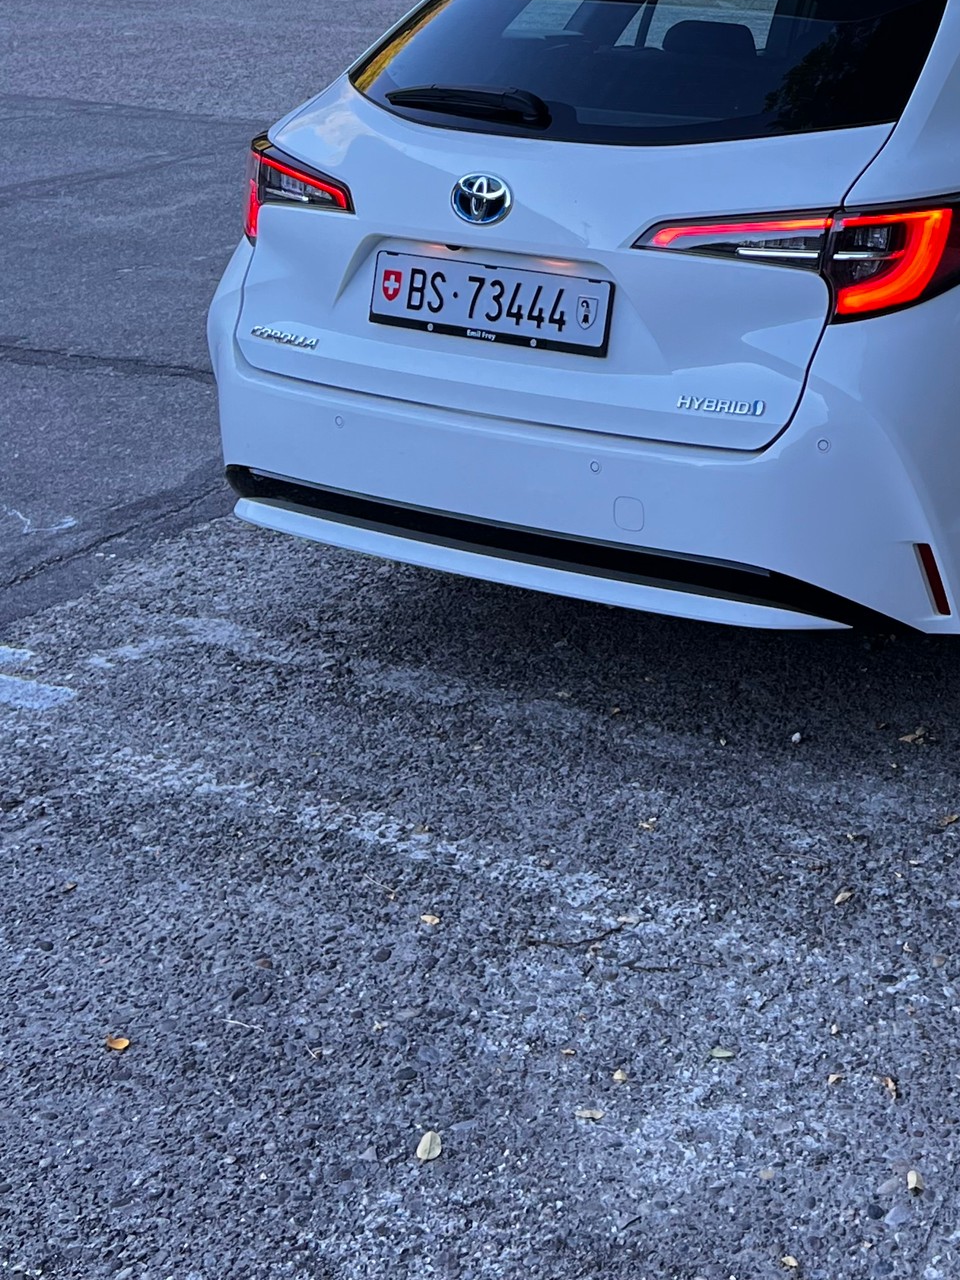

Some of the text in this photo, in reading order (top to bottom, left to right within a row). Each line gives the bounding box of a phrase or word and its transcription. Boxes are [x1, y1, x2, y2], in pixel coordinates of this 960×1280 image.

[250, 325, 319, 350] COROLLA
[466, 329, 496, 341] Emil Frey
[677, 395, 751, 416] HYBRID
